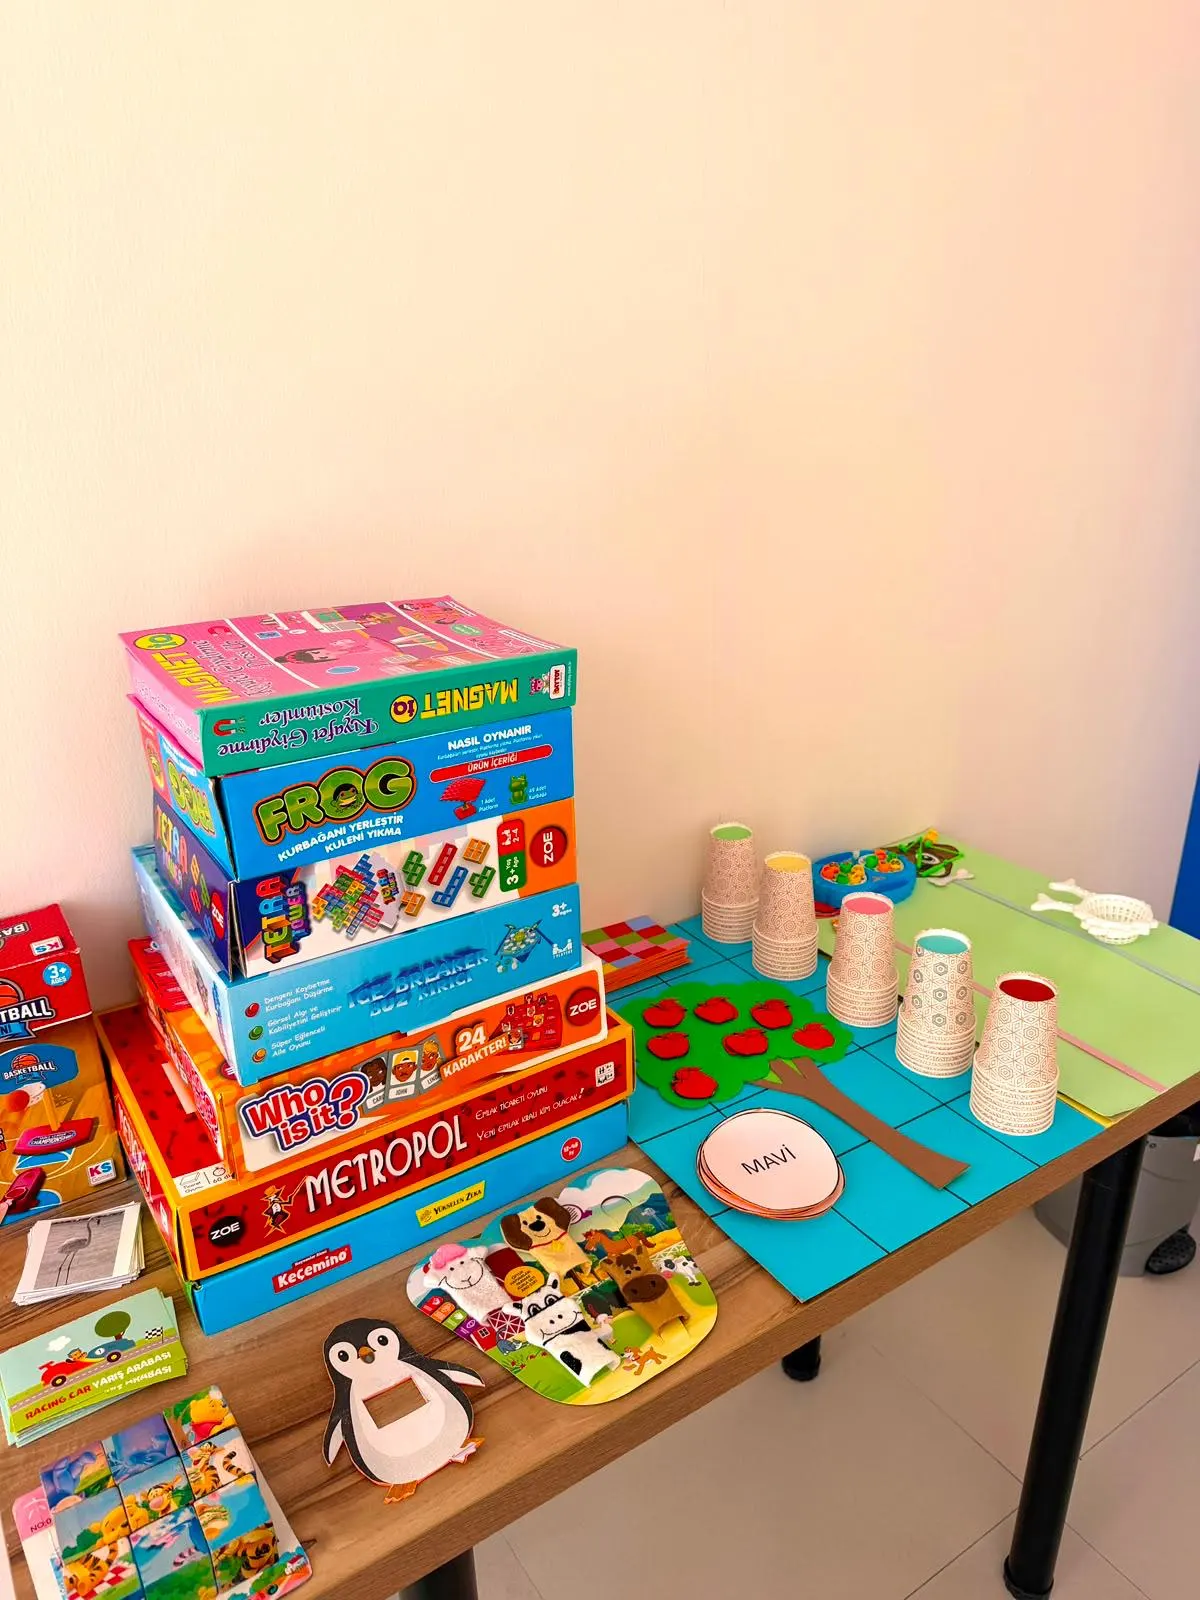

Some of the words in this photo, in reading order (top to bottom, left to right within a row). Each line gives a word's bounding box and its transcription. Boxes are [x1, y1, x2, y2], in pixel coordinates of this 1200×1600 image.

[258, 697, 362, 727] Kostümler
[420, 678, 519, 720] MAGNET
[218, 727, 308, 756] Giydirme
[313, 716, 380, 740] Kıyafet
[447, 735, 480, 751] NASIL
[483, 724, 532, 743] OYNANIR
[468, 758, 490, 773] ÜRÜN
[490, 752, 518, 768] İÇERİĞİ
[255, 758, 414, 843] FROG
[155, 806, 188, 874] TETRA
[277, 827, 346, 862] KURBAĞANI
[349, 812, 404, 833] YERLEŞTİR
[324, 831, 365, 854] KULENİ
[366, 827, 402, 840] YIKMA
[543, 832, 554, 865] ZOE
[211, 901, 224, 928] ZOE
[256, 876, 297, 960] TETRA
[285, 884, 308, 940] TOWER
[552, 902, 568, 917] 3+
[48, 965, 67, 979] 3+
[51, 976, 67, 985] AGES
[267, 1013, 292, 1028] Görsel
[569, 998, 598, 1017] ZOE
[271, 1036, 293, 1052] Süper
[458, 1025, 487, 1053] 24
[4, 1061, 56, 1080] BASKETBALL
[247, 1083, 326, 1133] Who
[476, 1106, 498, 1120] EMLAK
[280, 1119, 310, 1148] is
[89, 1162, 112, 1177] KS
[306, 1114, 468, 1213] METROPOL
[741, 1144, 797, 1175] MAVİ
[433, 1198, 464, 1216] YÜKSELEN
[465, 1189, 482, 1203] ZEKA
[210, 1222, 241, 1240] ZOE
[278, 1249, 347, 1288] Keçemino
[25, 1397, 67, 1421] RACING
[69, 1385, 92, 1399] CAR
[92, 1371, 125, 1390] YARIŞ
[126, 1352, 172, 1375] ARABASI
